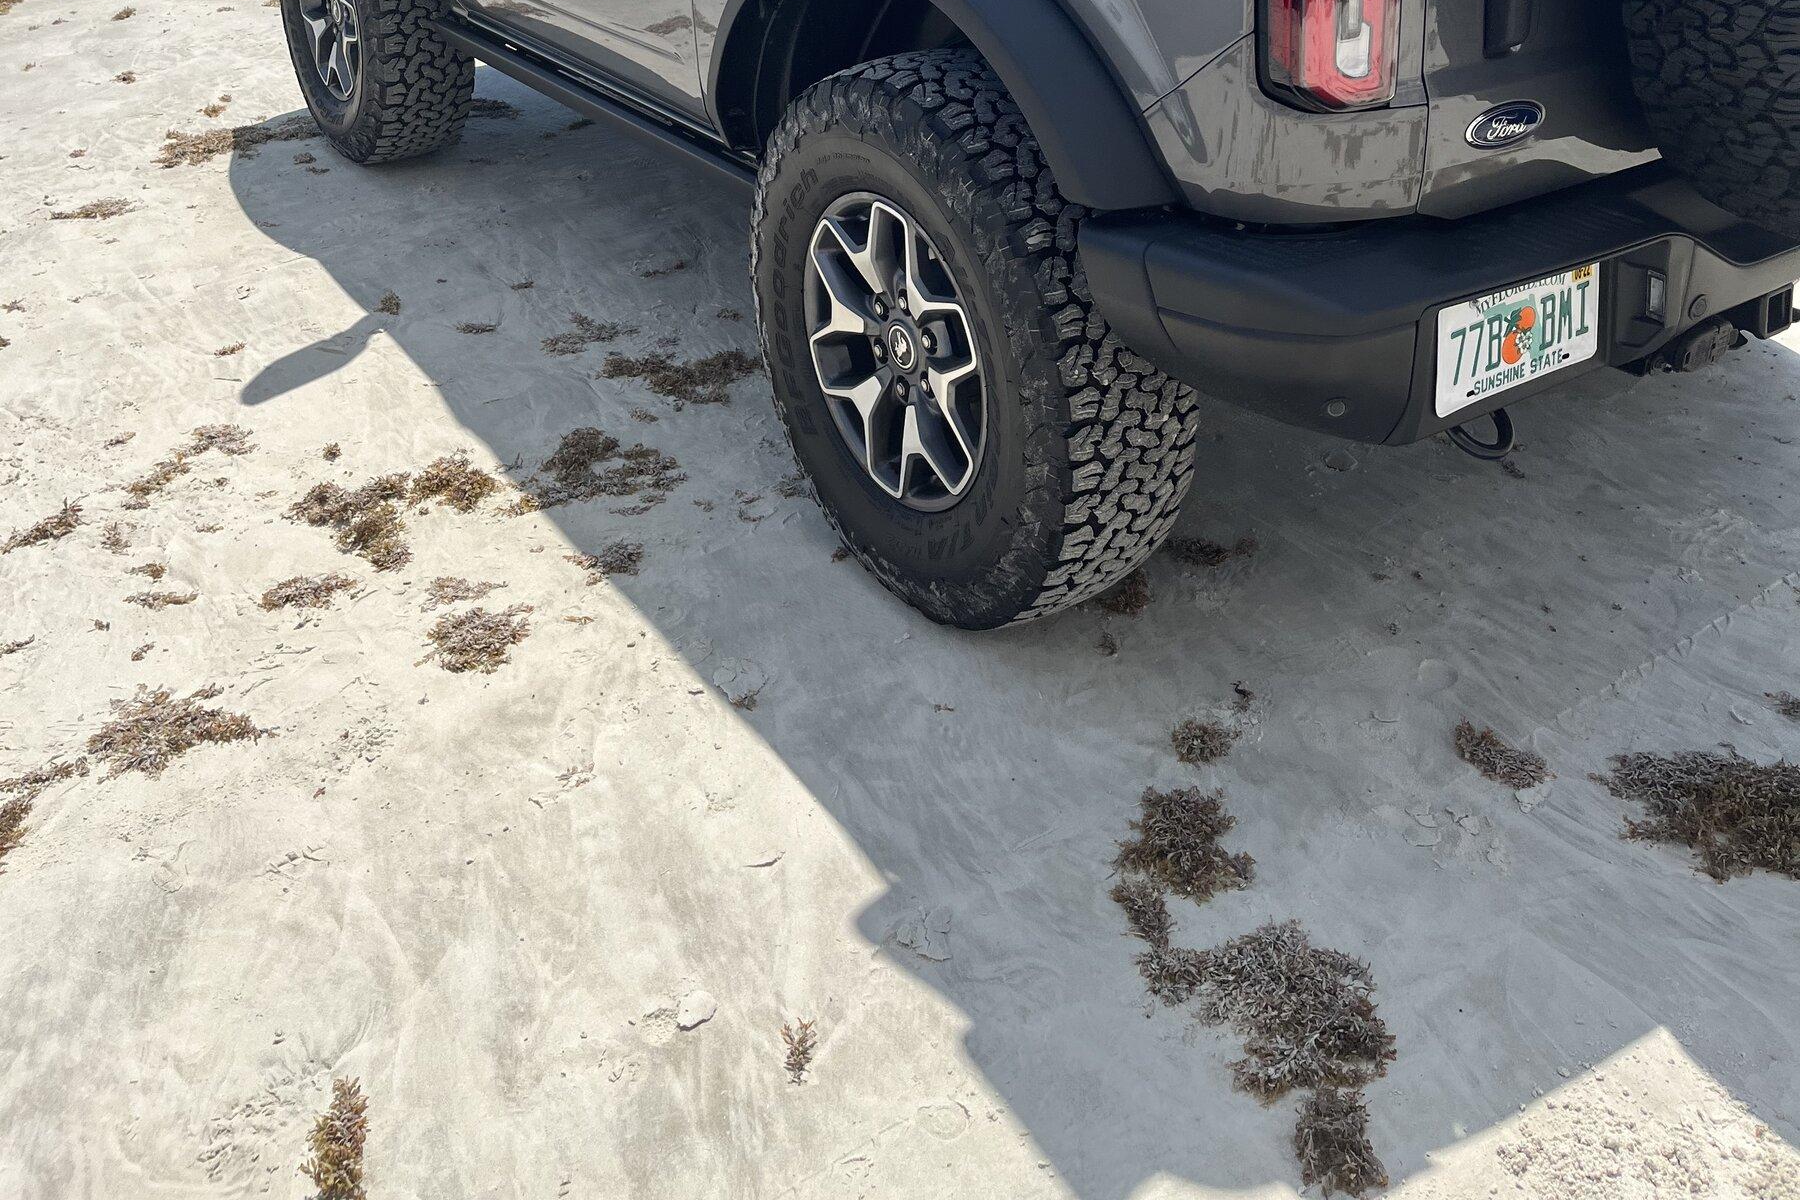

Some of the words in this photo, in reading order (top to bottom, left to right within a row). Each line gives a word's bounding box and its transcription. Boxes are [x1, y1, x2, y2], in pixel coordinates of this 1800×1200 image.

[1486, 115, 1528, 140] Ford
[1473, 362, 1525, 396] SUNSHINE
[1530, 348, 1563, 373] STATE
